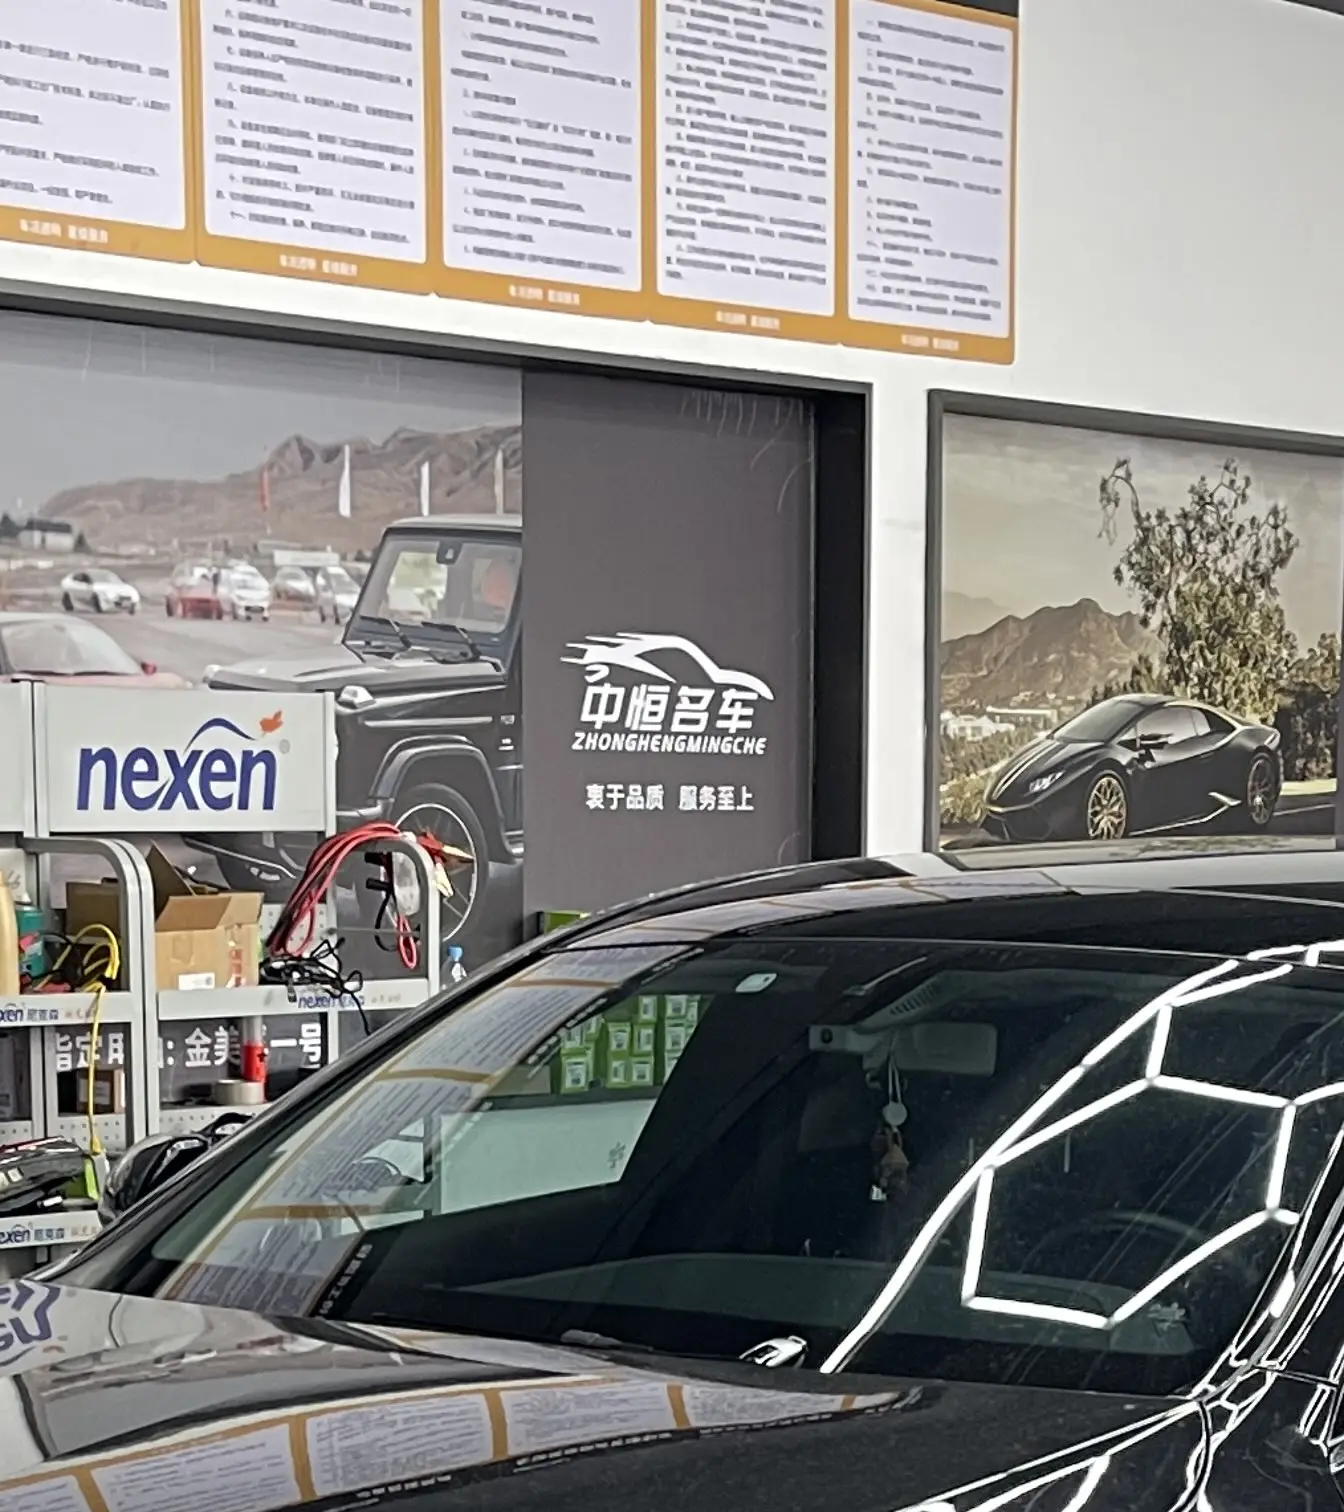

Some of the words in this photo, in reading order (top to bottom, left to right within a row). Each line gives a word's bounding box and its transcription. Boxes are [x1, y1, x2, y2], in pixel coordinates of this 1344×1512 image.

[580, 683, 759, 733] 中恒名车
[571, 731, 768, 755] ZHONGHENGMINGCHE
[77, 747, 277, 812] nexen
[678, 785, 755, 811] 服务至上
